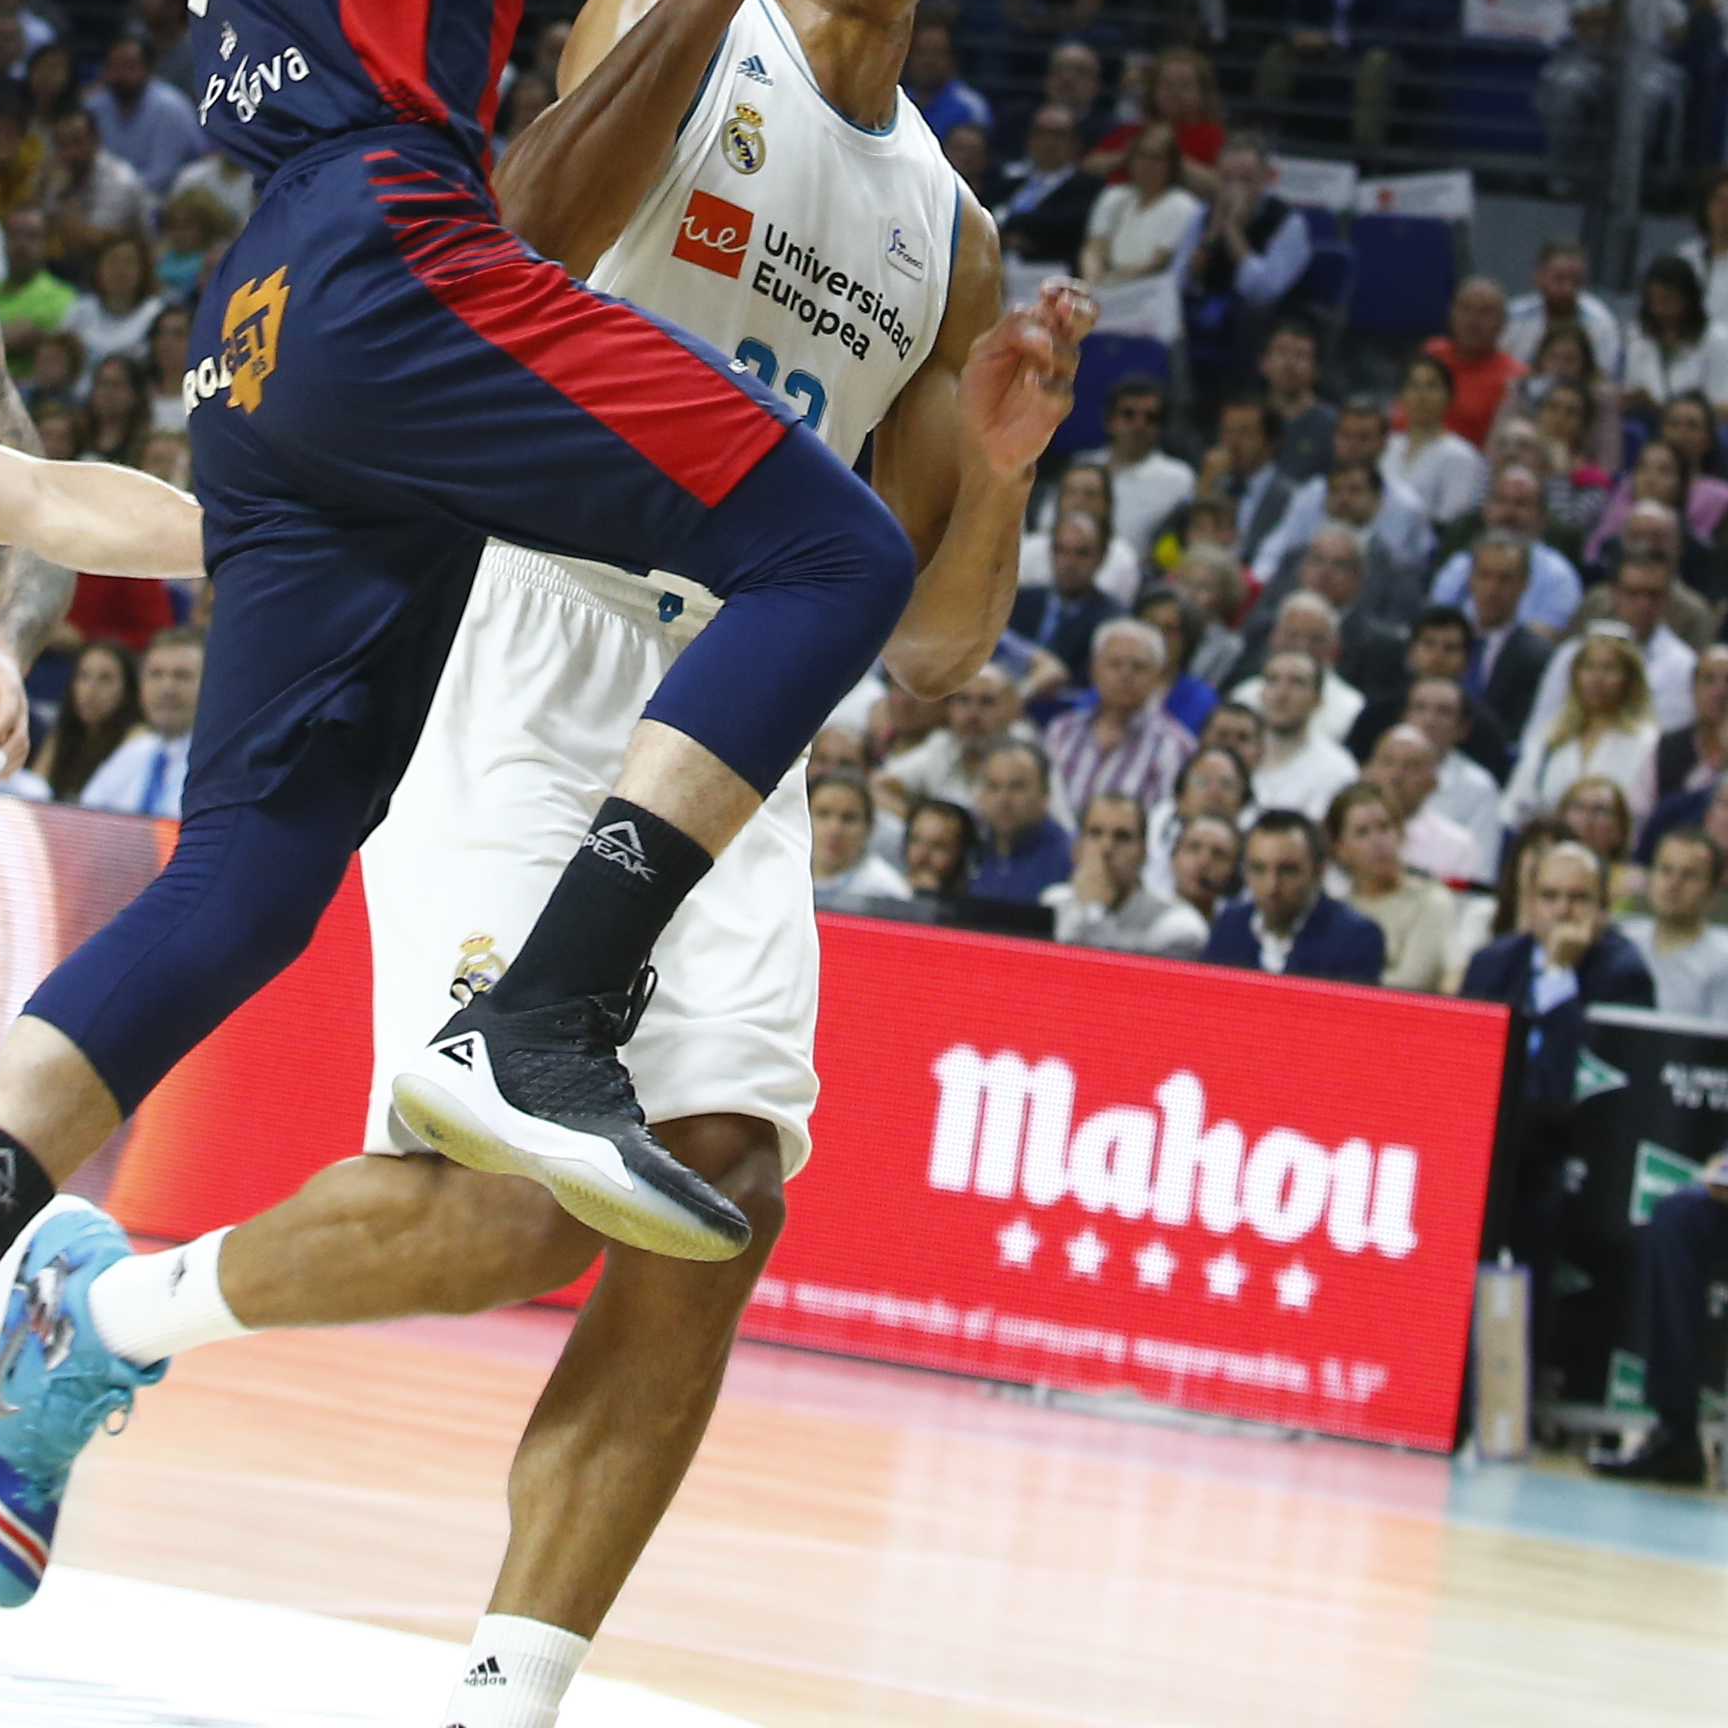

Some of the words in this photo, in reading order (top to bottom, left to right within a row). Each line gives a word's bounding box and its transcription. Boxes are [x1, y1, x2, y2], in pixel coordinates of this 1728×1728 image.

[751, 261, 871, 361] Europea
[764, 223, 915, 362] Universidad
[581, 832, 659, 884] PEAK
[925, 1041, 1421, 1262] Mahou
